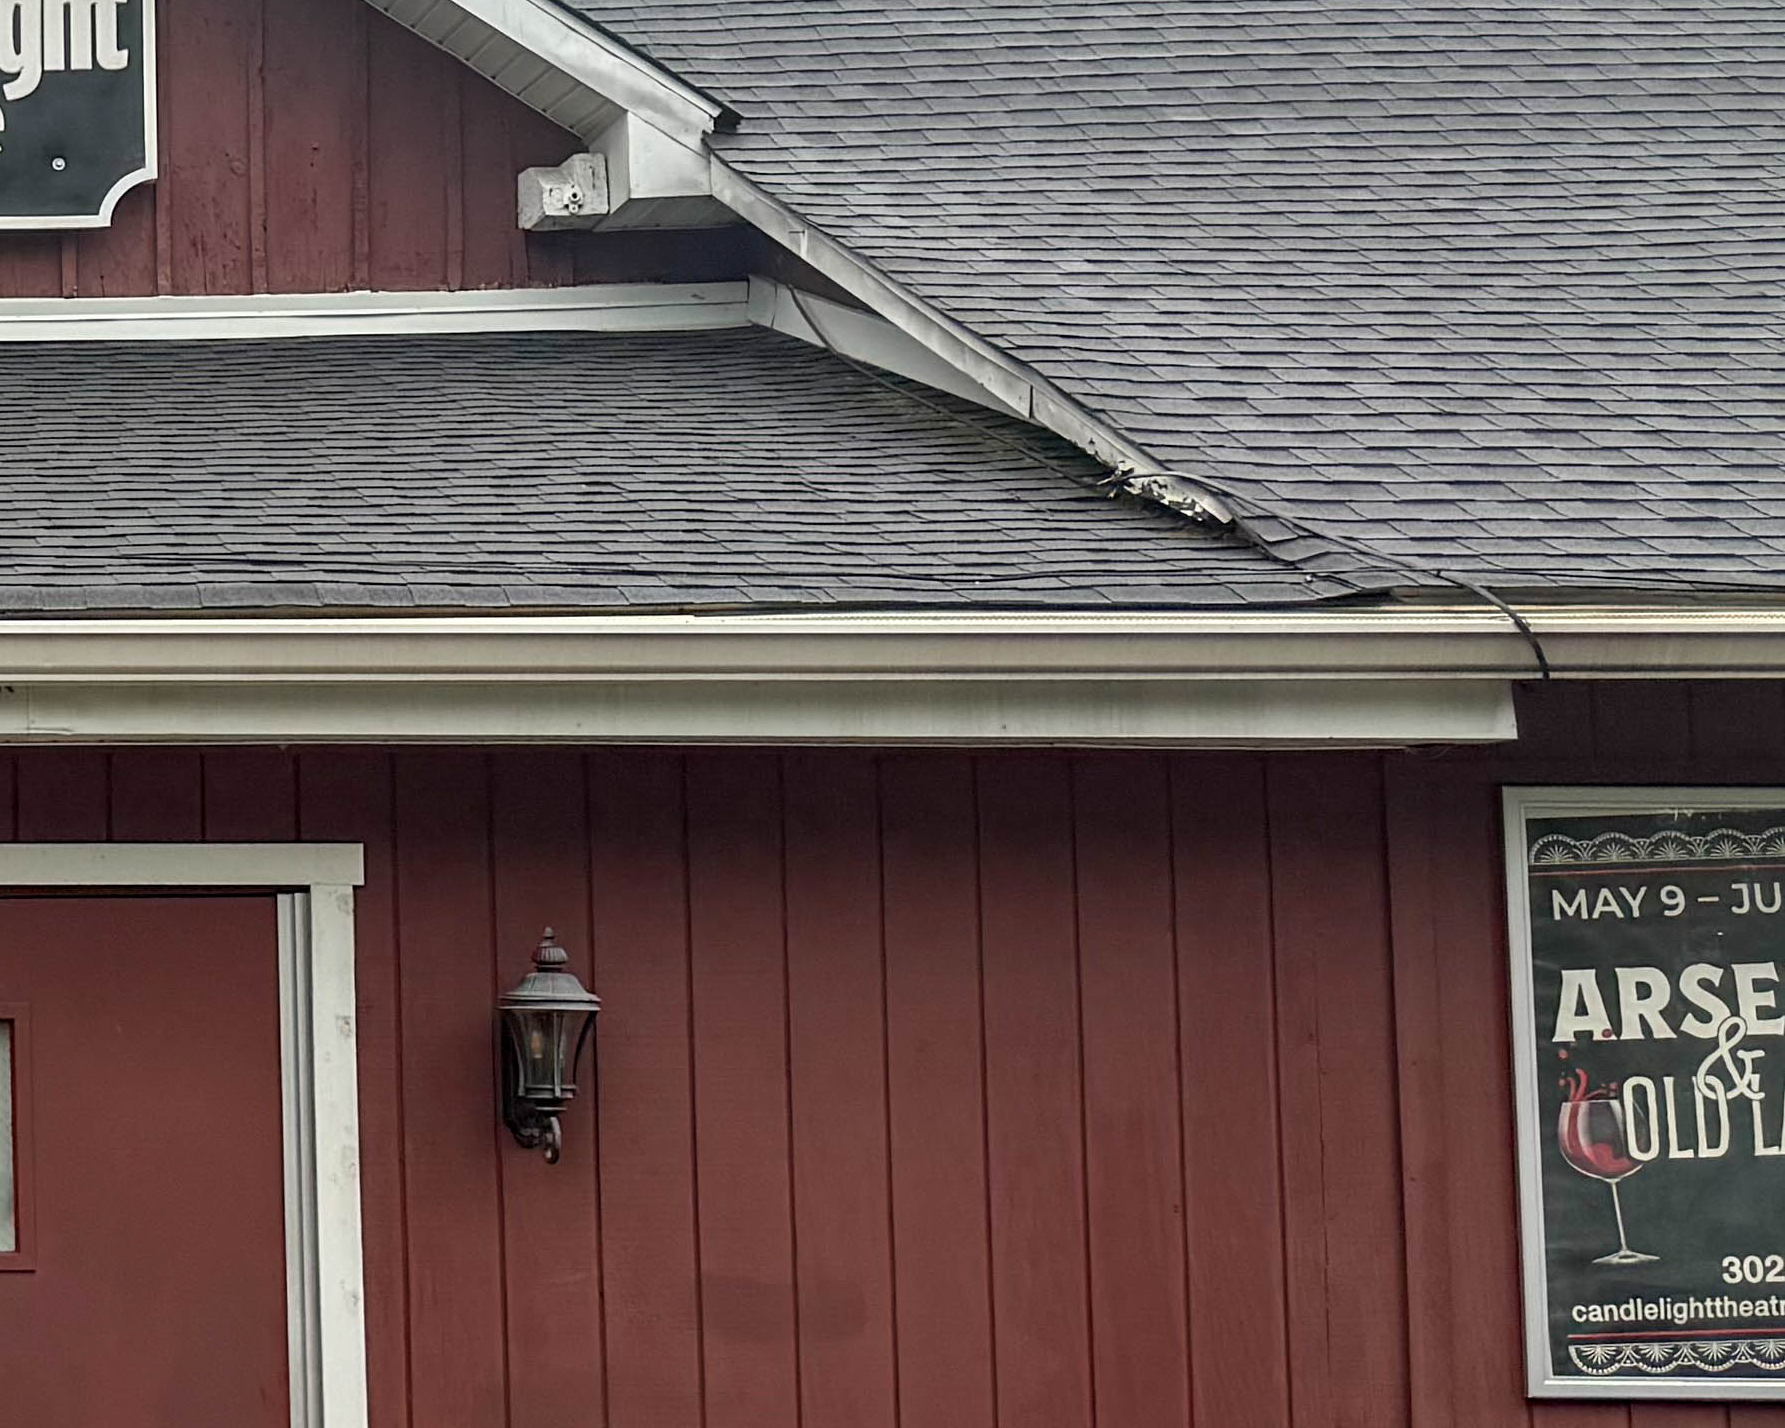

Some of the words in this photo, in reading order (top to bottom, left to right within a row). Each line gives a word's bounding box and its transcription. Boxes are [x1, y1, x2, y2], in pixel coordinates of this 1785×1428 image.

[1552, 886, 1647, 920] MAY
[1660, 884, 1686, 917] 9
[1552, 962, 1785, 1042] ARSE
[1697, 1016, 1766, 1100] &
[1623, 1075, 1730, 1161] OLD
[1750, 1074, 1785, 1156] L
[1722, 1254, 1785, 1284] 302
